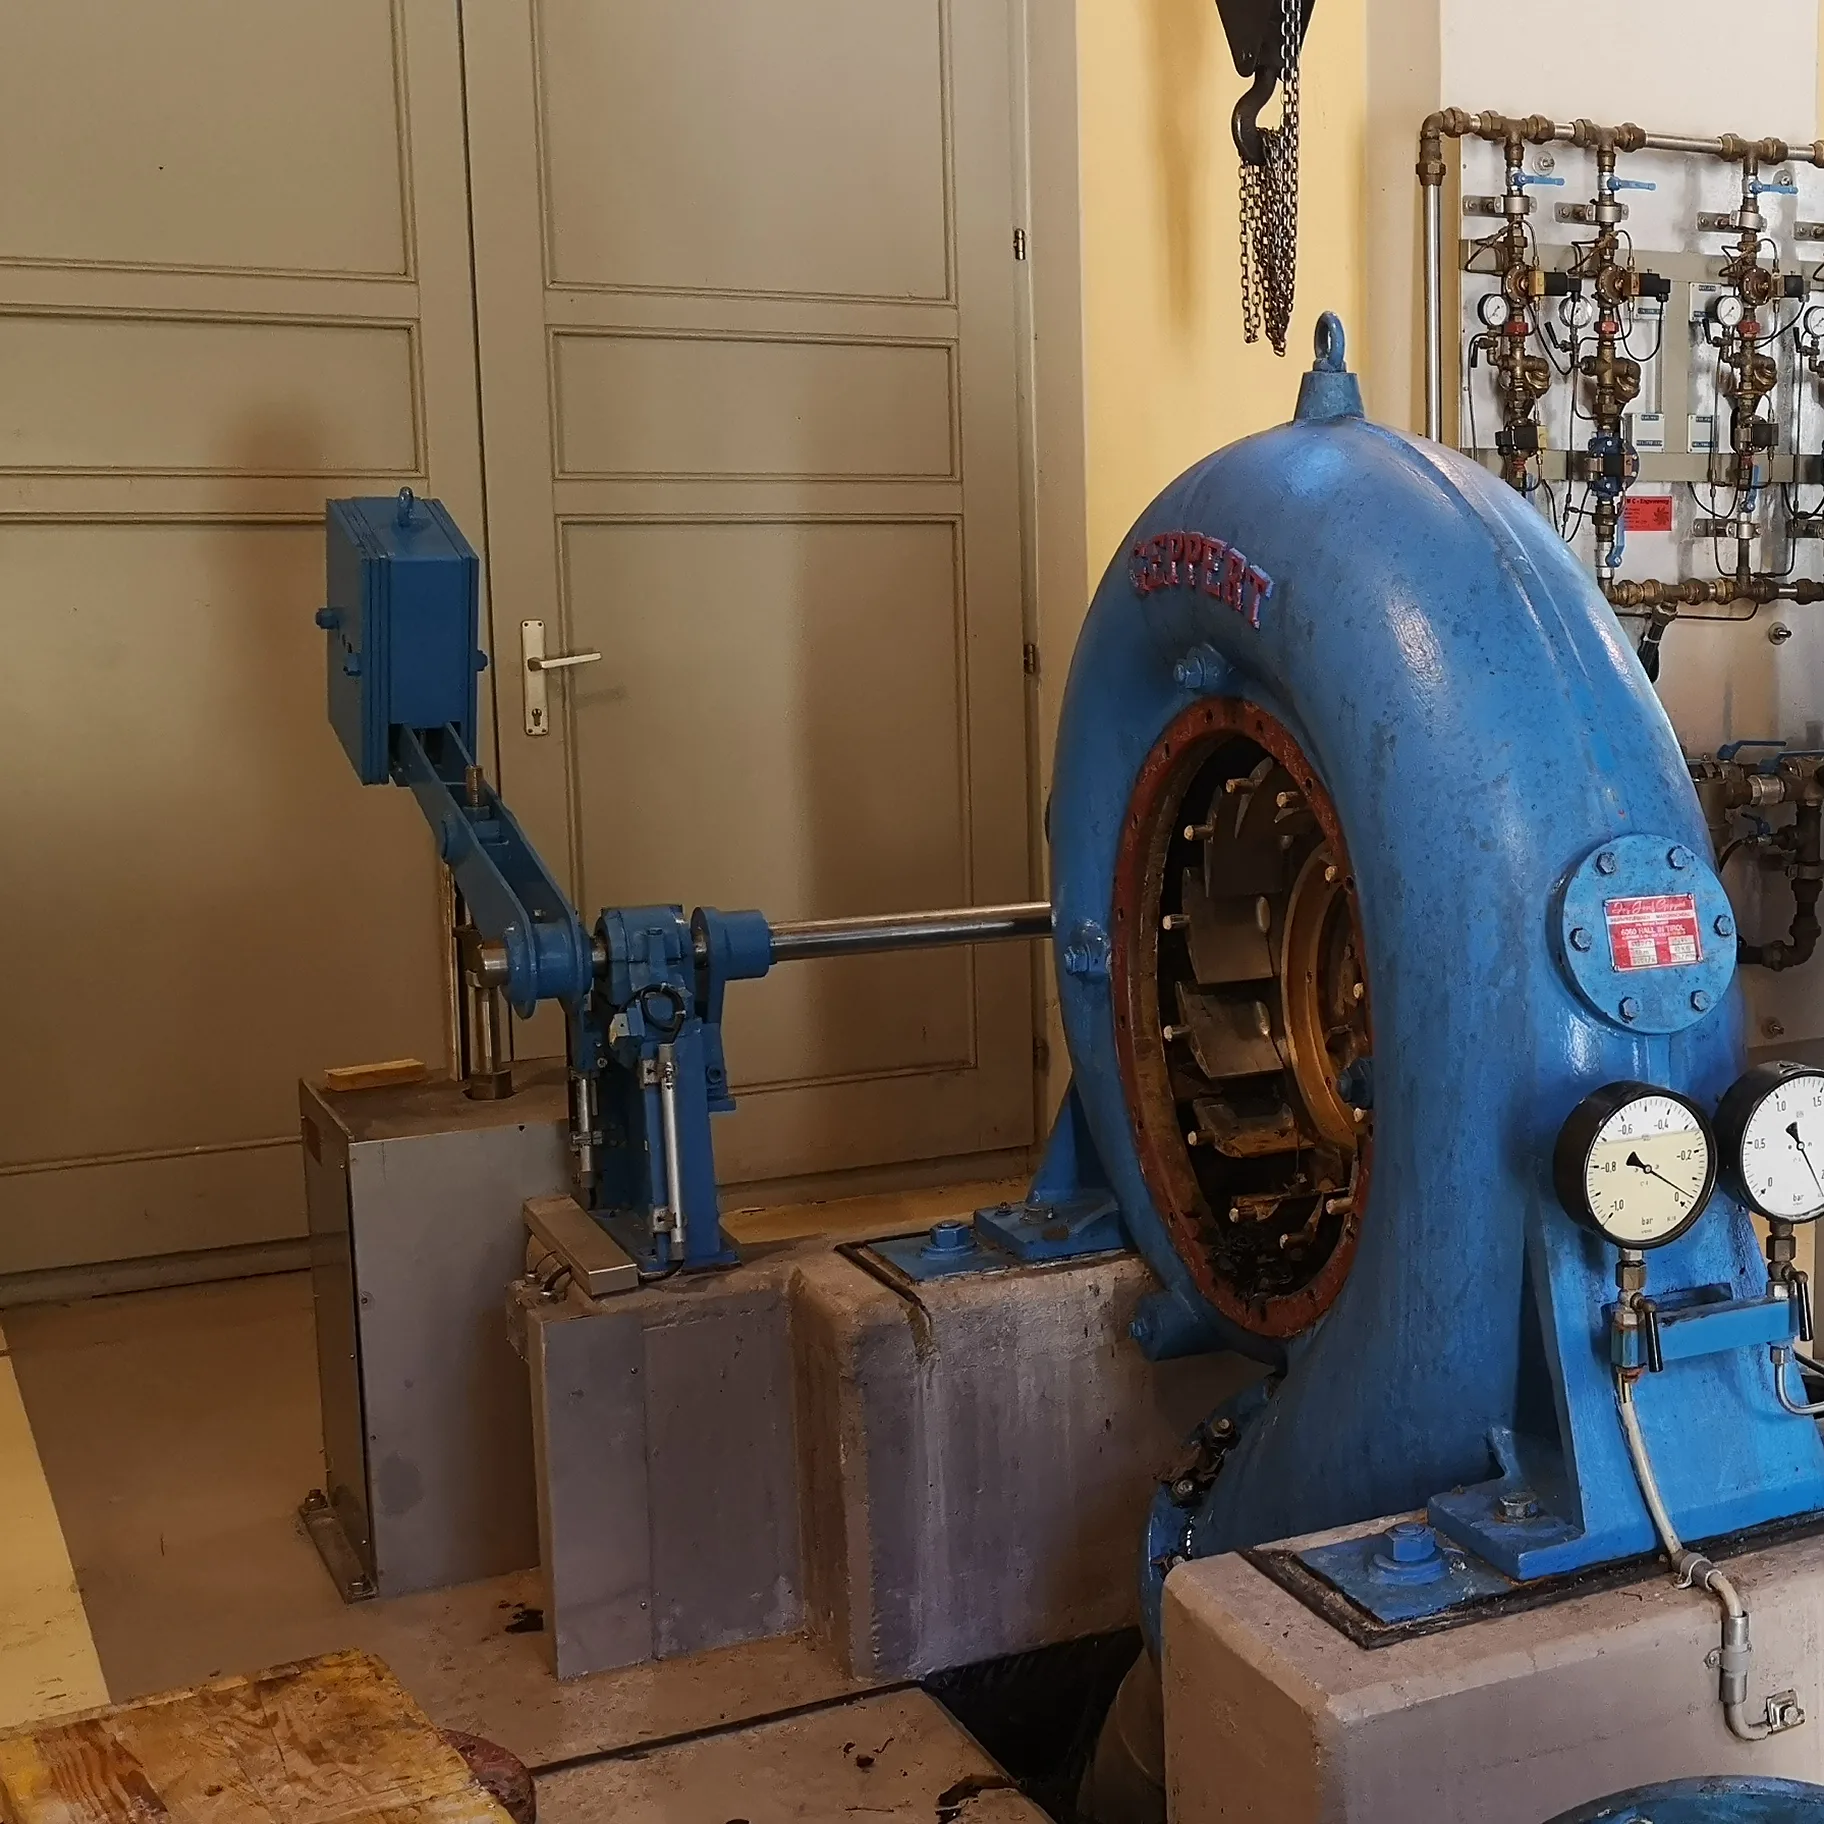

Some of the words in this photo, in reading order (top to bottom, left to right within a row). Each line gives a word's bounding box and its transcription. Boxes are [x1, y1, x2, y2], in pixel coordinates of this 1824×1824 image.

[1638, 926, 1656, 934] HALL
[1666, 924, 1686, 932] TIROL
[1768, 1177, 1773, 1187] 0
[1674, 1191, 1680, 1202] 0
[1792, 1194, 1804, 1202] bar
[1641, 1217, 1653, 1226] bar
